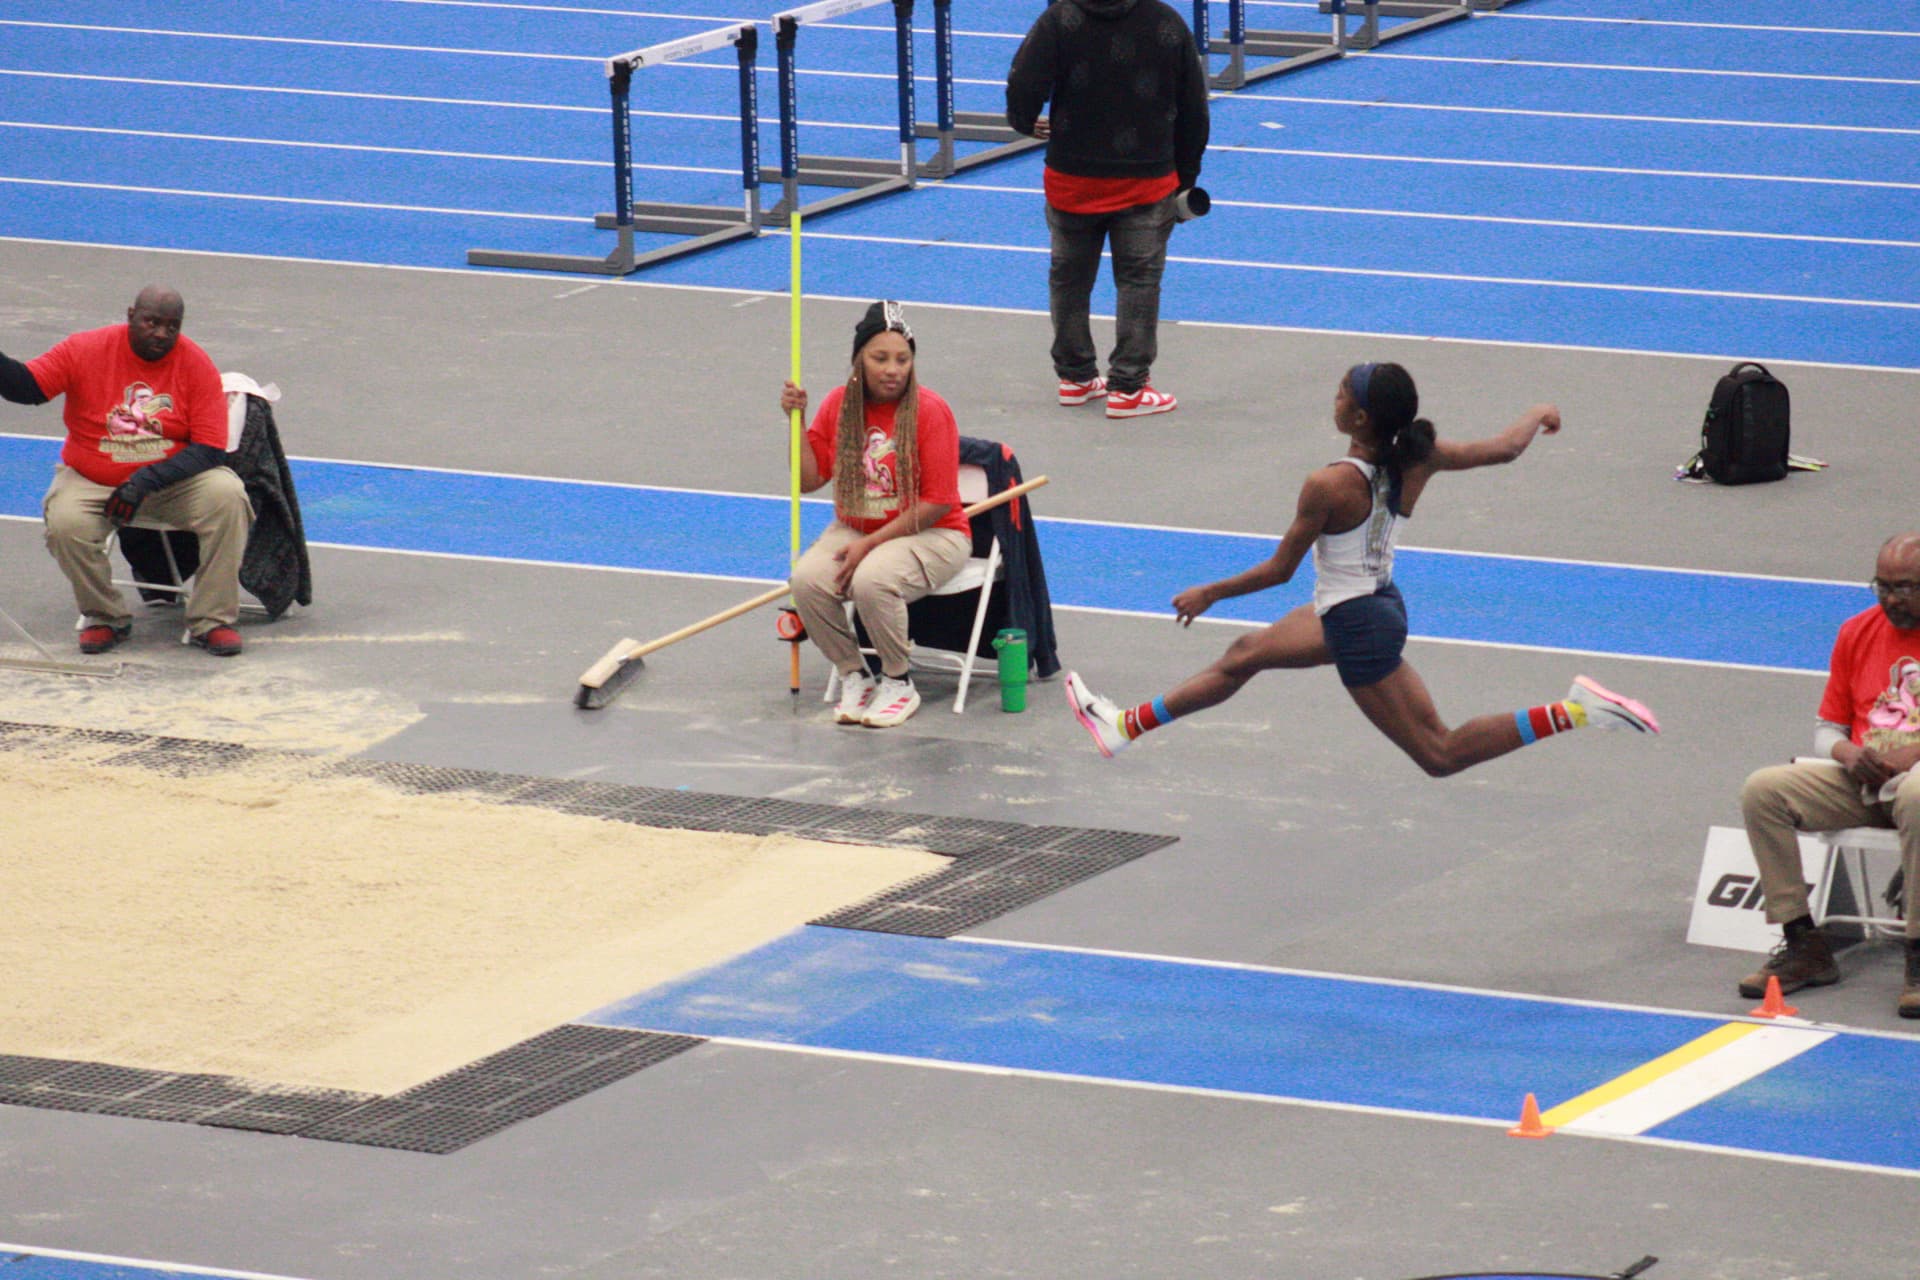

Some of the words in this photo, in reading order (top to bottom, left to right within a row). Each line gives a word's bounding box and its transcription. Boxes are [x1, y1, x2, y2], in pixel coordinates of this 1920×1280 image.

[749, 67, 757, 133] VIRGINIA
[908, 96, 916, 136] BEACH
[623, 102, 631, 168] VIRGINIA
[626, 176, 634, 218] BEACH
